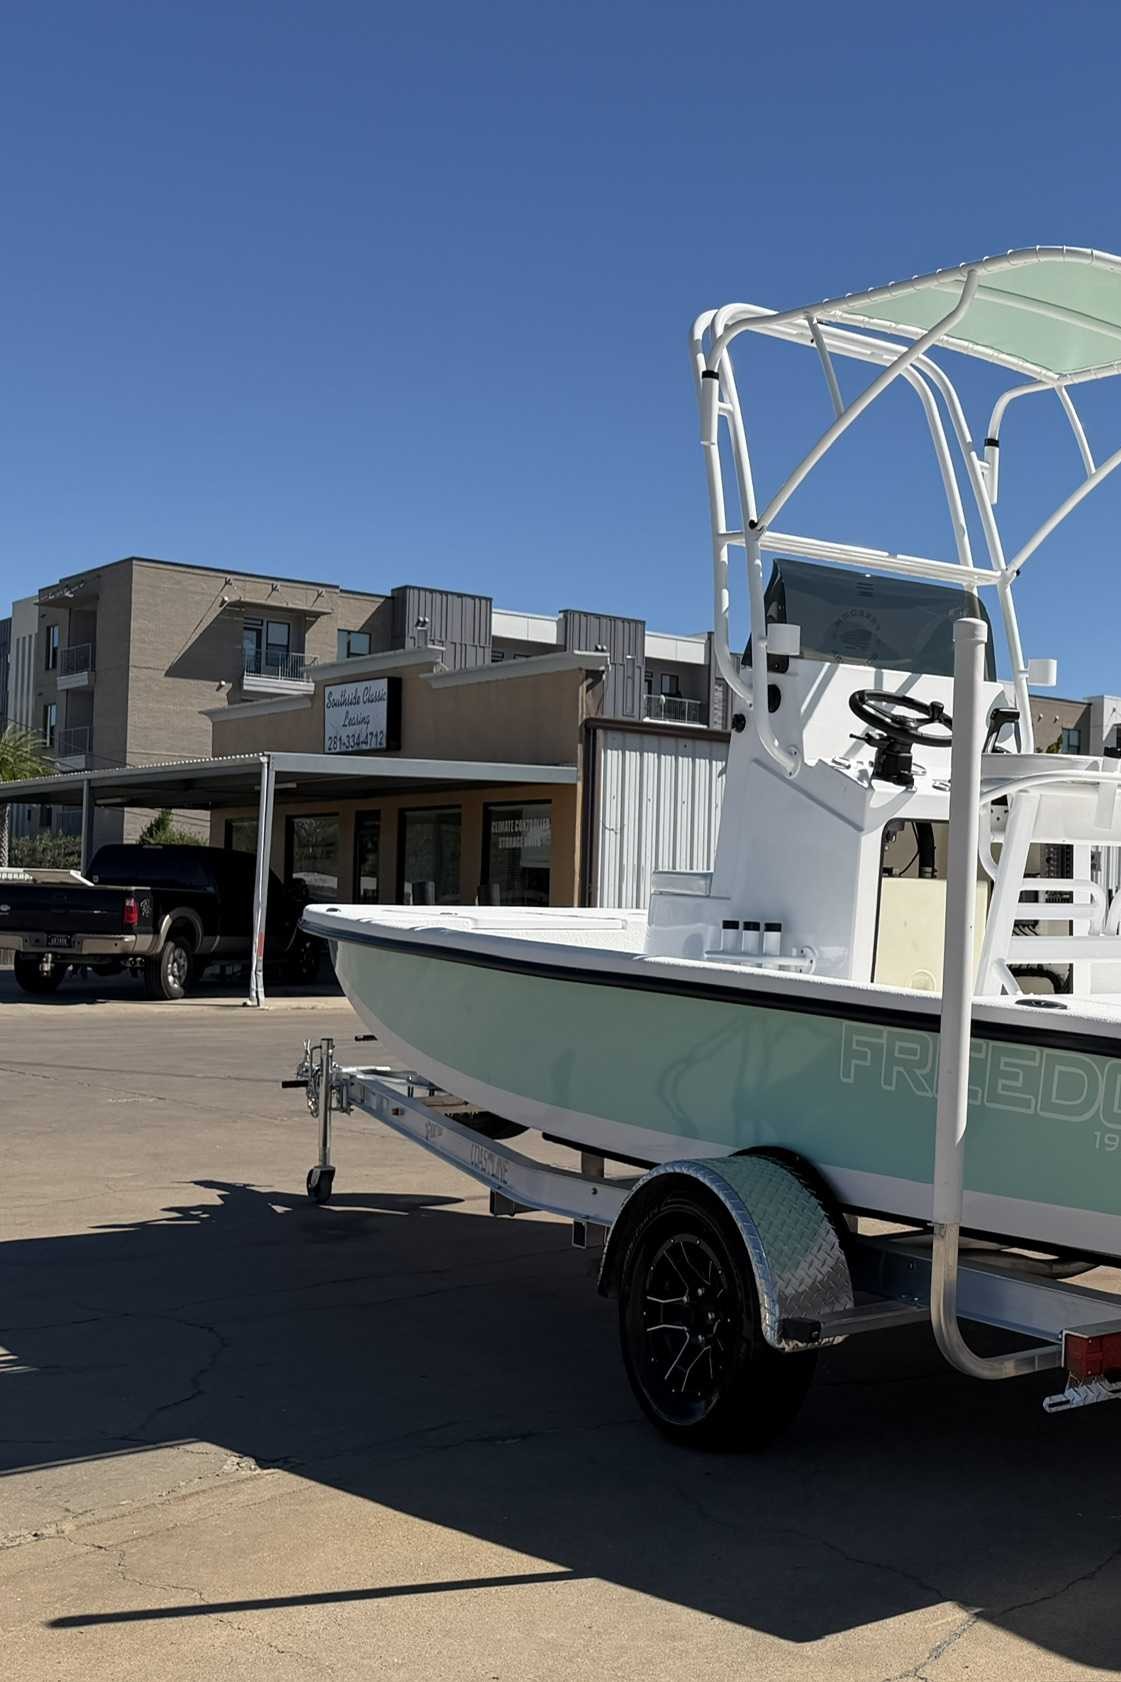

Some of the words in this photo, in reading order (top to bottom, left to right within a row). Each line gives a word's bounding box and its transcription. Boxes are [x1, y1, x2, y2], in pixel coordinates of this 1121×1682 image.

[326, 688, 361, 709] Southside
[362, 685, 387, 705] Classic
[342, 710, 371, 733] Leasing
[327, 730, 385, 751] 281-334-4712
[1094, 1131, 1119, 1151] 19
